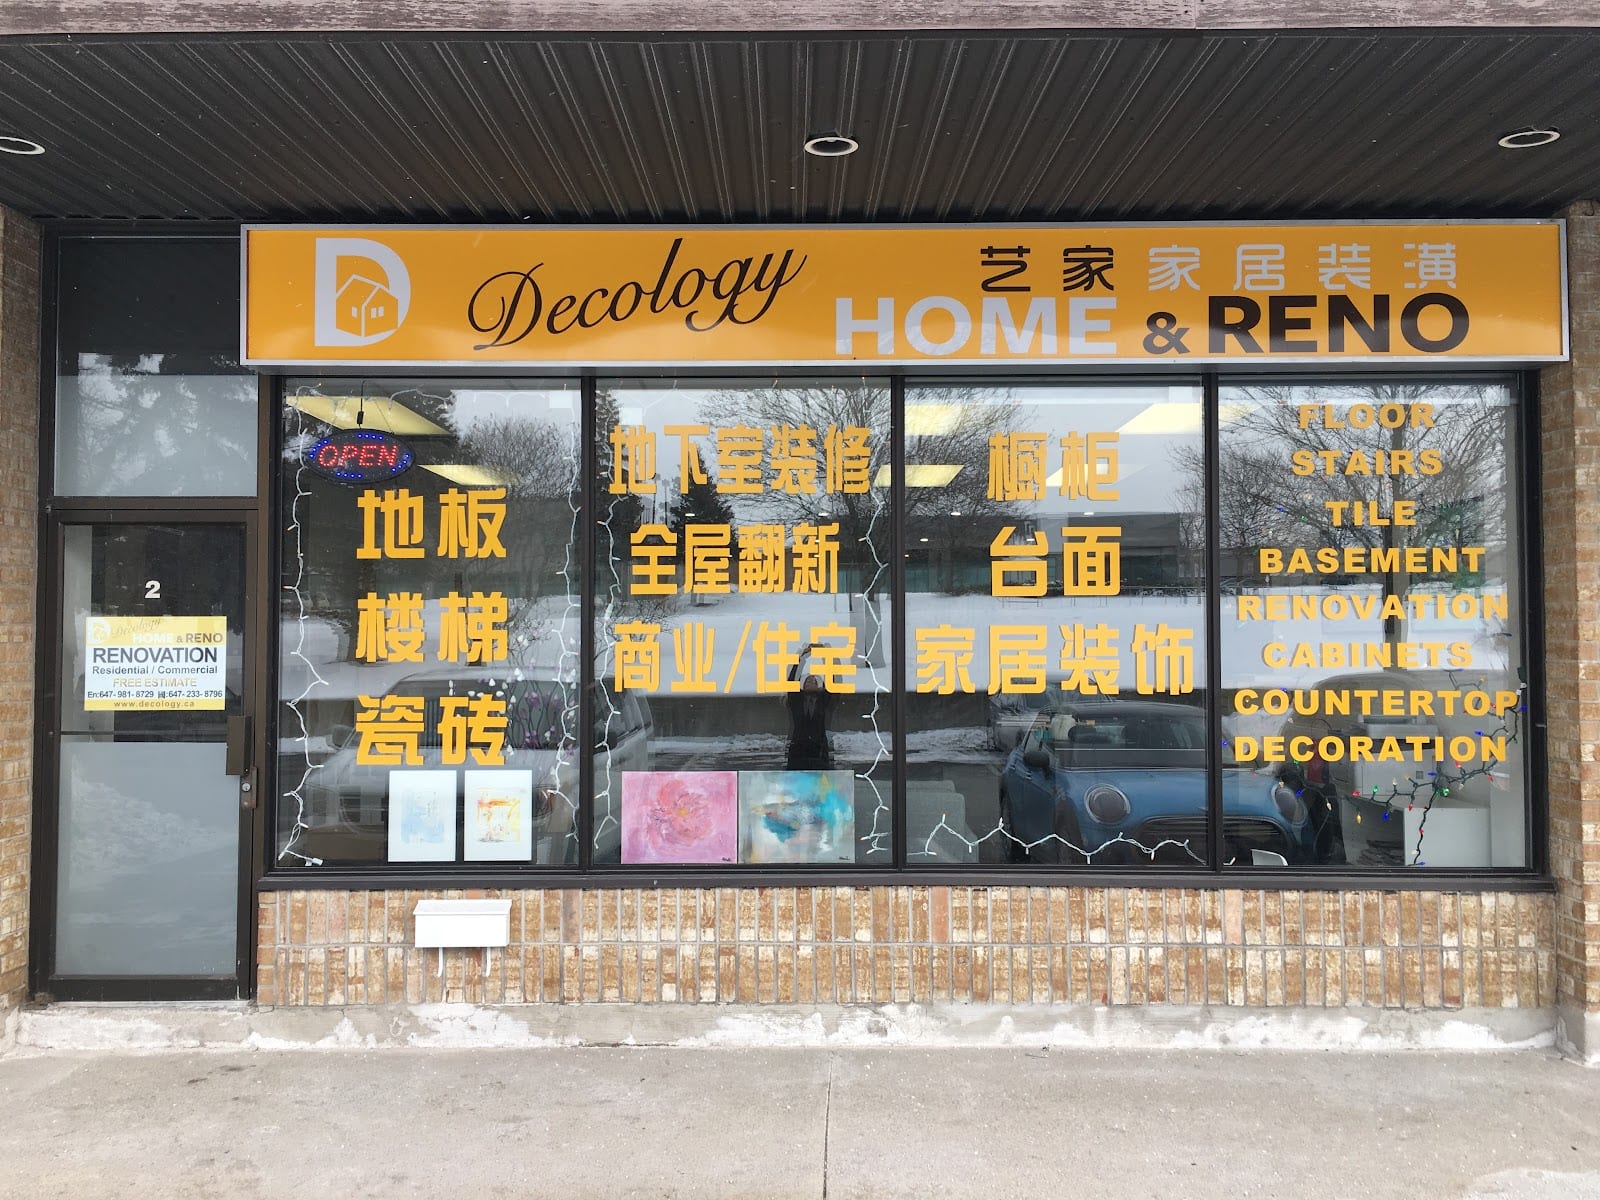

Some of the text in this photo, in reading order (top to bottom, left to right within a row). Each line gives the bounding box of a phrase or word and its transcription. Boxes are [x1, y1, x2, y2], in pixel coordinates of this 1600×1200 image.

[467, 238, 808, 351] Decology
[835, 292, 1470, 356] HOME & RENO
[1297, 403, 1436, 430] FLOOR
[317, 443, 399, 469] OPEN
[609, 424, 871, 496] 地下室装修
[986, 431, 1121, 502] 橱柜
[1291, 449, 1443, 477] STAIRS
[356, 487, 507, 560] 地板
[1324, 500, 1417, 527] TILE
[630, 522, 840, 595] 全屋翻新
[989, 526, 1122, 597] 台面
[1259, 546, 1486, 574] BASEMENT
[144, 580, 161, 599] 2
[1237, 594, 1509, 621] RENOVATION
[185, 632, 224, 644] RENO
[355, 591, 509, 663] 楼梯
[93, 647, 218, 664] RENOVATION
[614, 620, 857, 694] 商业/住宅
[915, 623, 1195, 696] 家居装饰
[1262, 642, 1473, 669] CABINETS
[92, 665, 149, 675] Residential
[157, 665, 218, 675] Commercial
[113, 677, 198, 688] FREE ESTIMATE
[113, 700, 196, 709] www.decology.ca
[1233, 688, 1520, 718] COUNTERTOP
[355, 693, 509, 766] 瓷砖
[1233, 735, 1508, 763] DECORATION
